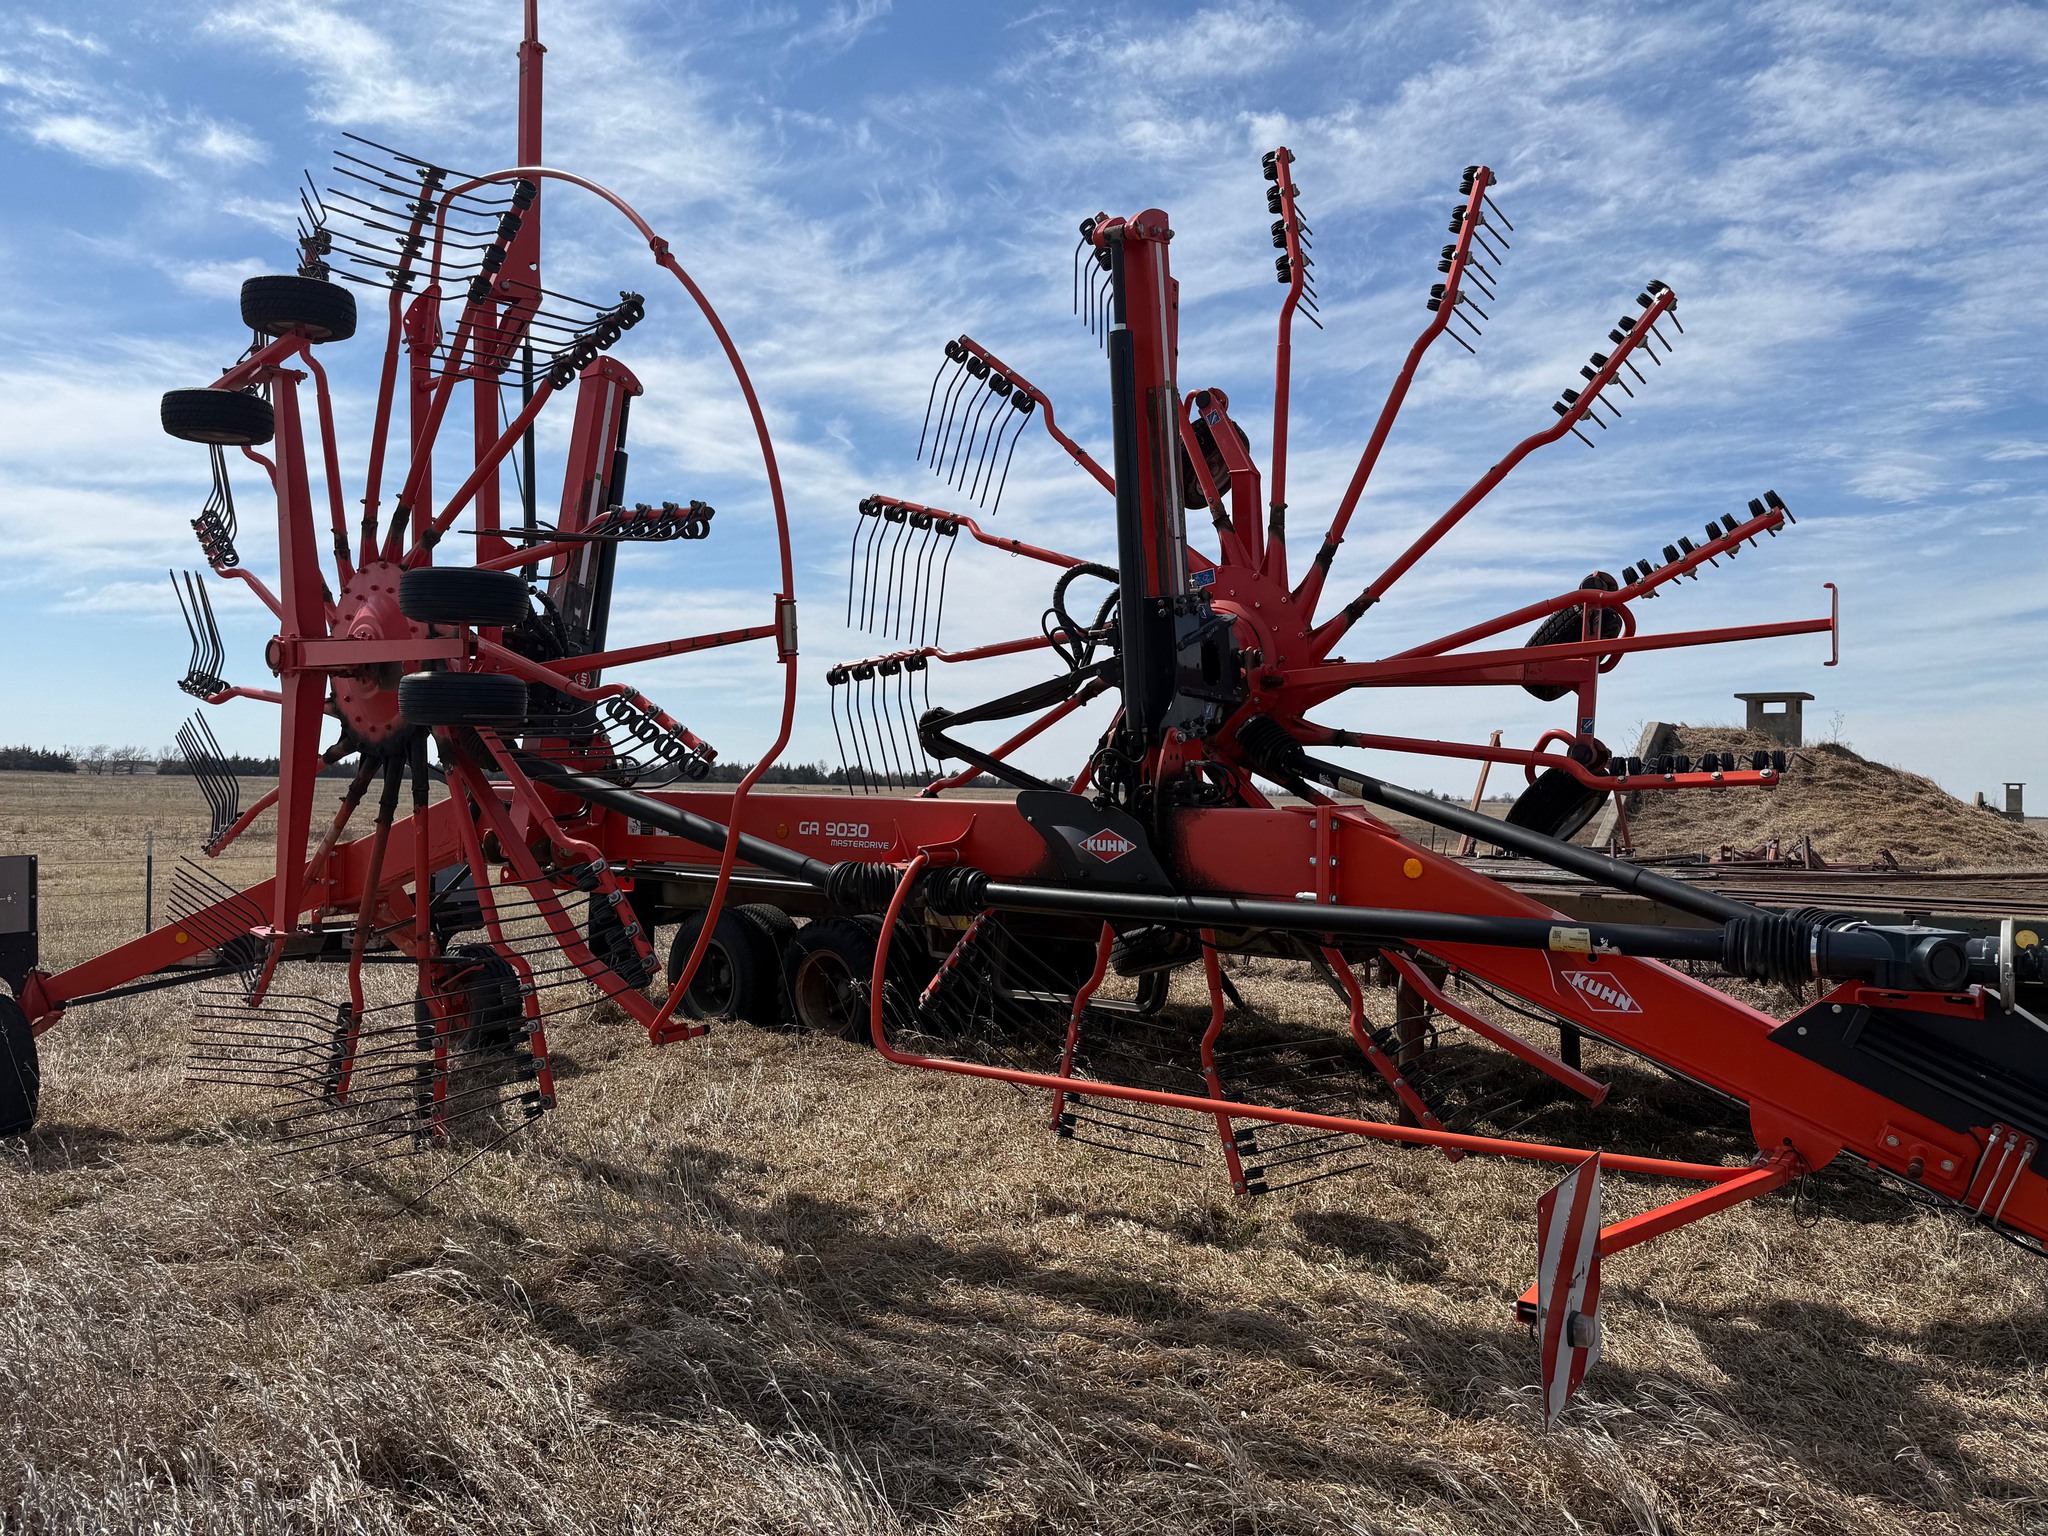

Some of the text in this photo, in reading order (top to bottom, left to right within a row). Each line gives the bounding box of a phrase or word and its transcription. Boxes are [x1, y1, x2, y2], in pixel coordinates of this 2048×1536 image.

[798, 821, 870, 838] GA 9030
[830, 839, 890, 849] MASTERDRIVE
[1086, 839, 1128, 852] KUHN
[1571, 971, 1633, 1011] KUHN
